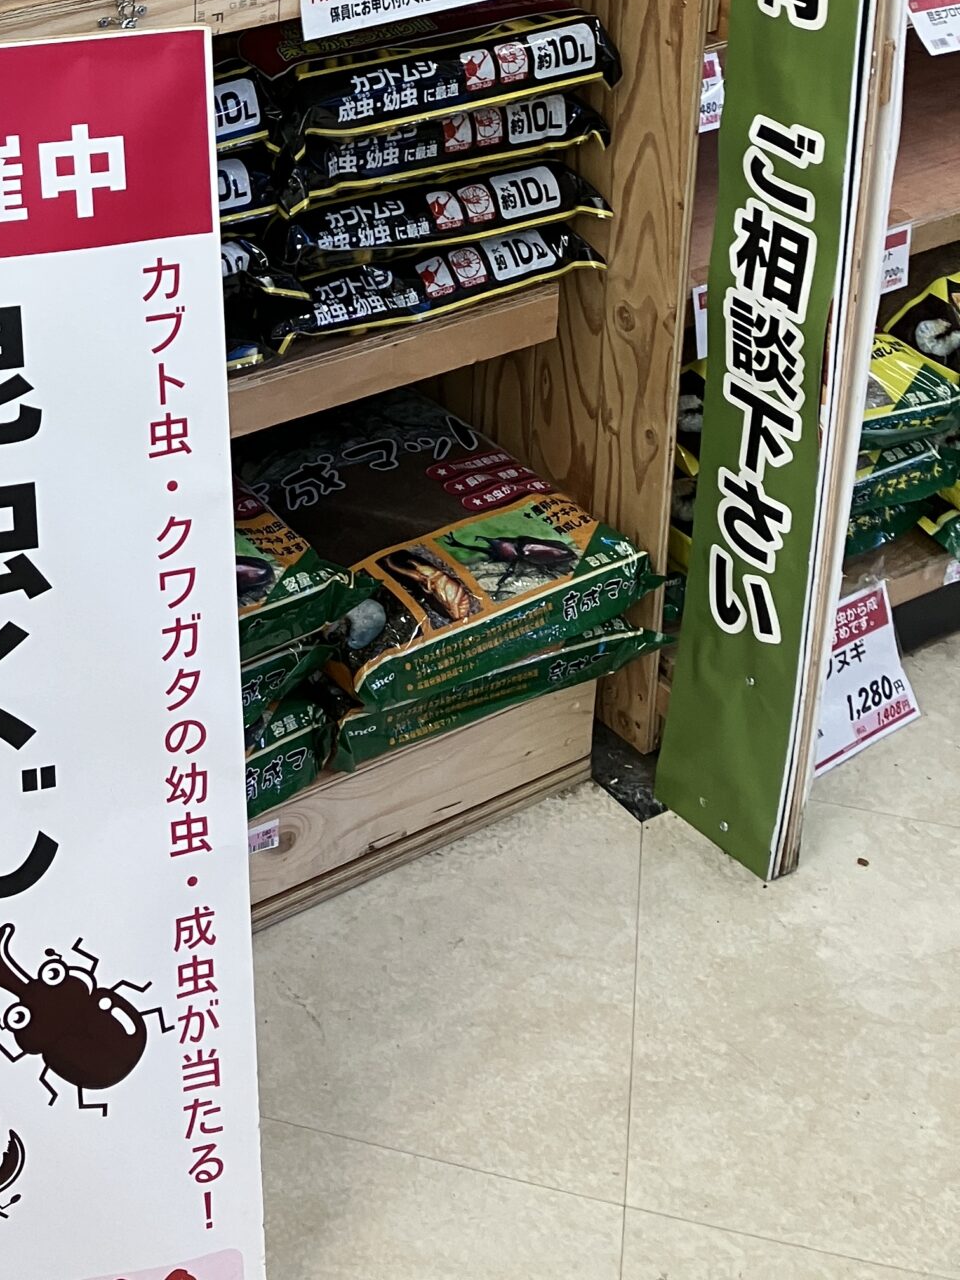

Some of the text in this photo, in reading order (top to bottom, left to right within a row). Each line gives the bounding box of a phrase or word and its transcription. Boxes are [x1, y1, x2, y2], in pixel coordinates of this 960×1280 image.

[325, 199, 405, 229] カブトムシ
[350, 60, 437, 95] カブトムシ
[714, 120, 818, 639] ご相談下さい
[140, 256, 226, 1232] カブト虫・クワガタの幼虫・成虫が当たる！
